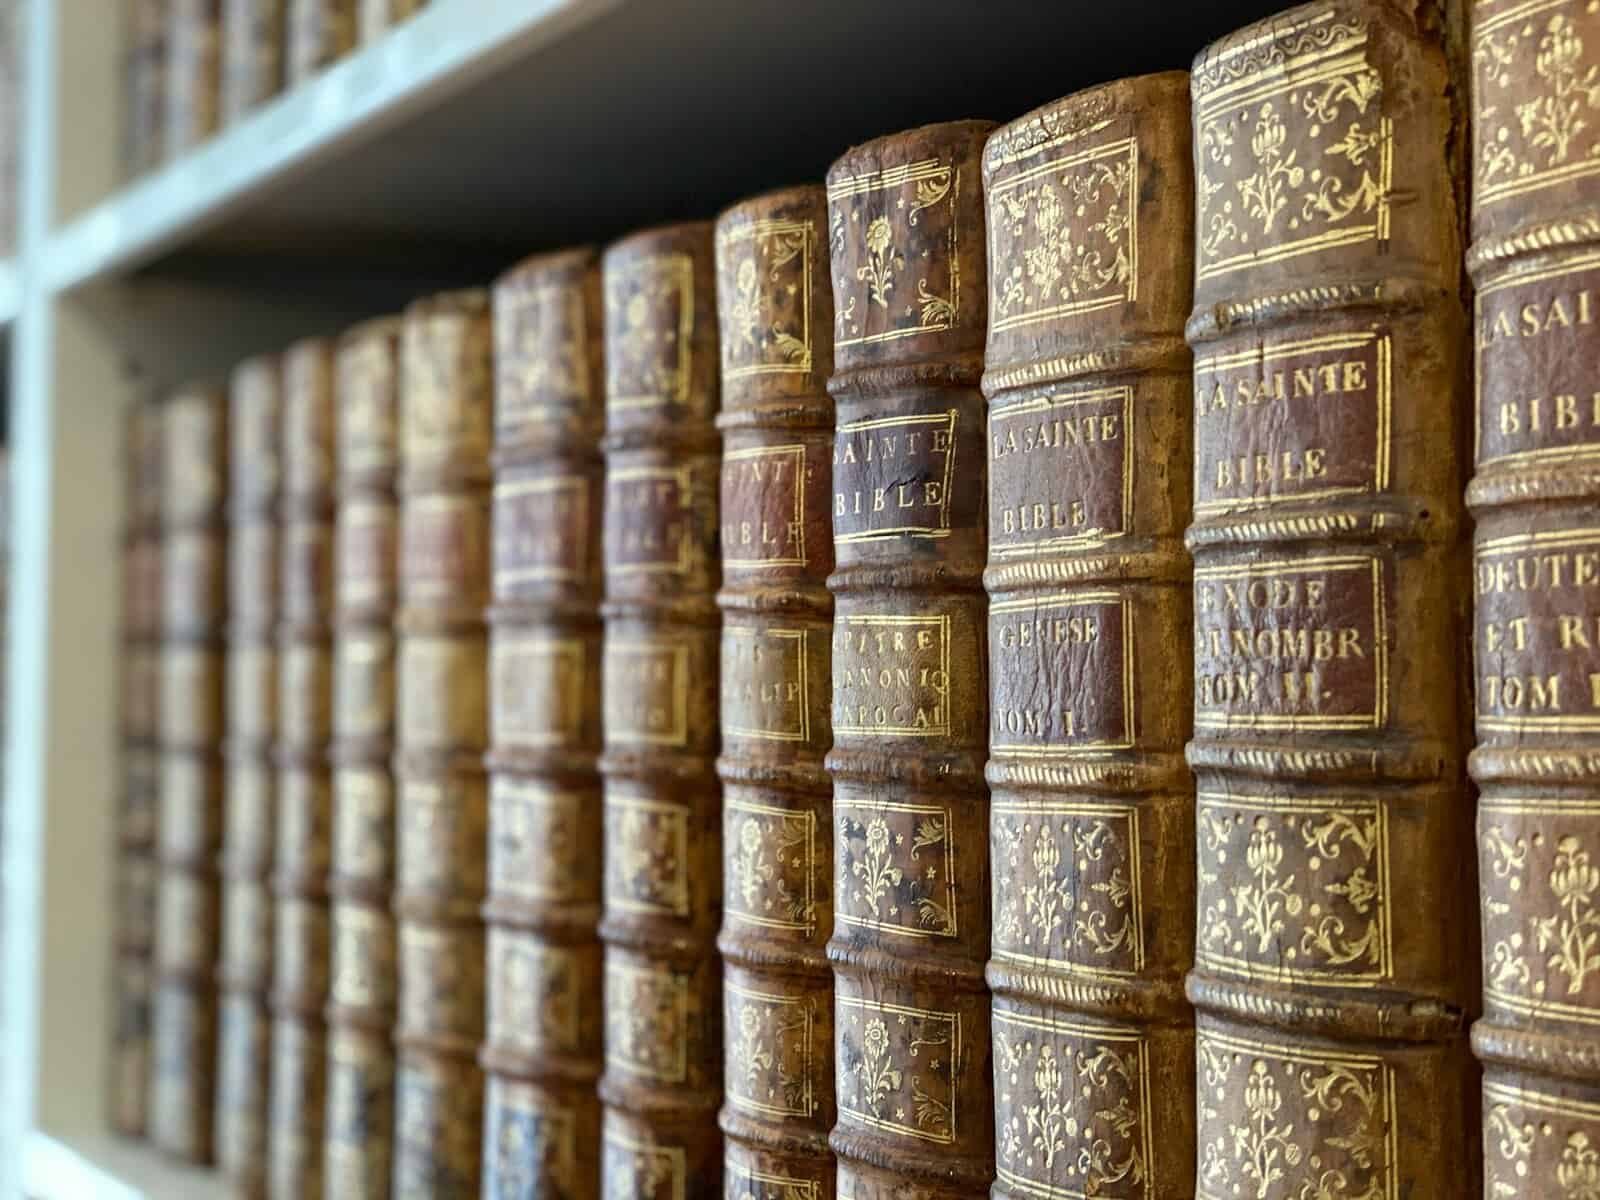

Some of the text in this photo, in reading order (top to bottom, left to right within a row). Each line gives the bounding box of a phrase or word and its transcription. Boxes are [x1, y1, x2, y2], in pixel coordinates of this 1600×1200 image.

[1236, 360, 1368, 407] SAINTE
[993, 414, 1119, 460] LA SAINTE
[1216, 447, 1328, 489] BIBLE
[835, 481, 942, 517] BIBLE
[1003, 500, 1088, 535] BIBLE
[999, 616, 1099, 649] GENESE
[1231, 627, 1365, 660] NOMBR
[1484, 613, 1600, 653] ET R
[1485, 672, 1561, 711] TOM
[998, 708, 1044, 737] TOM
